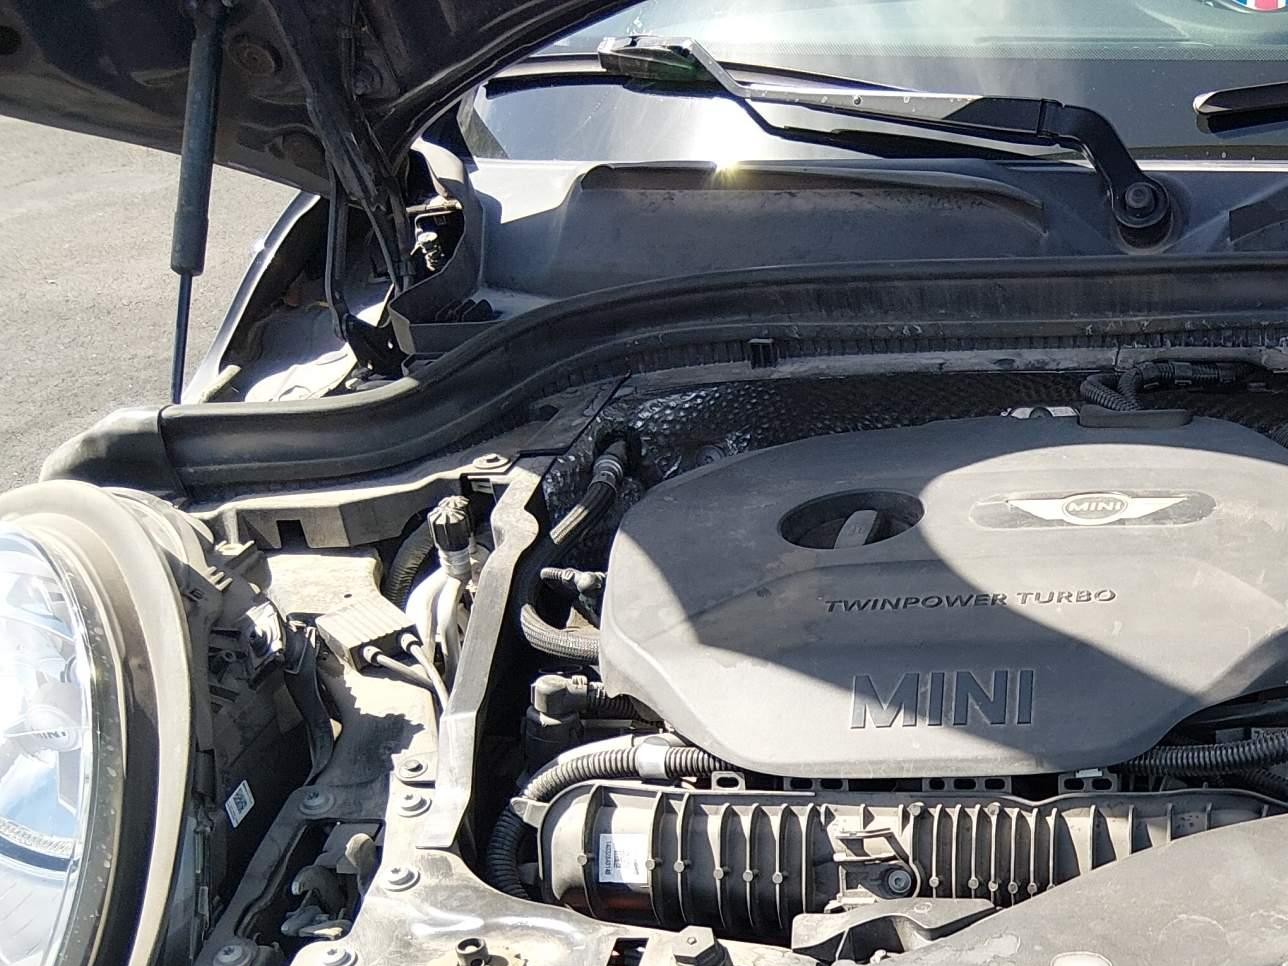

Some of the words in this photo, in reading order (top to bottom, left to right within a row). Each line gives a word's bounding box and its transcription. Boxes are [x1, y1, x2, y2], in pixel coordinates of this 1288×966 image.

[1067, 501, 1122, 512] MINI
[825, 593, 1007, 613] TWINPOWER
[1016, 590, 1117, 605] TURBO
[850, 669, 1034, 730] MINI
